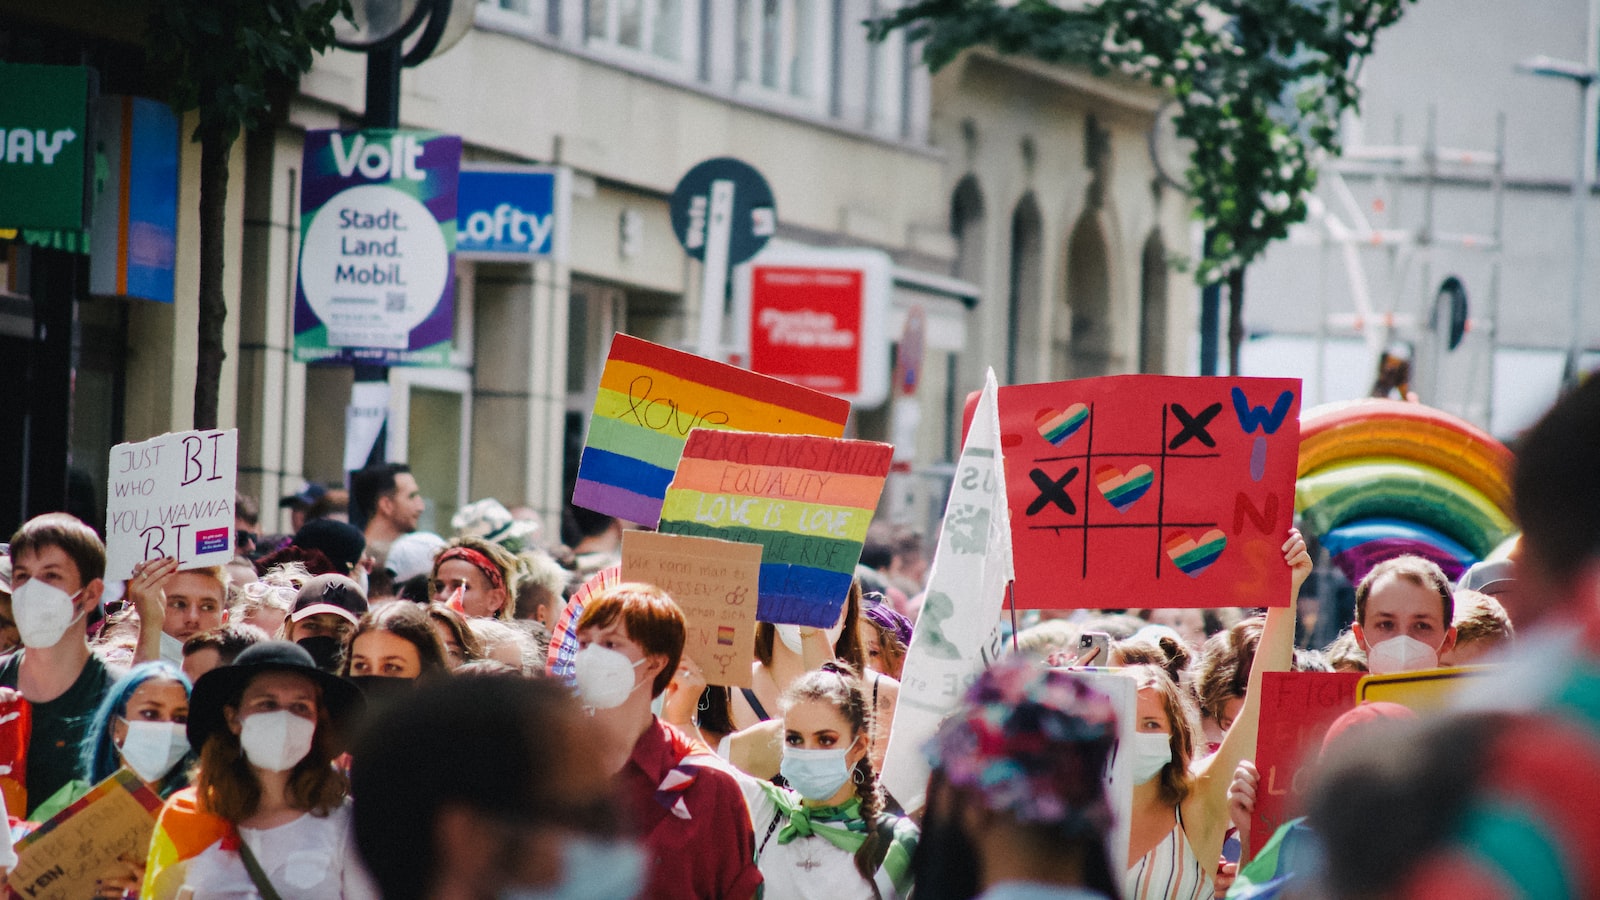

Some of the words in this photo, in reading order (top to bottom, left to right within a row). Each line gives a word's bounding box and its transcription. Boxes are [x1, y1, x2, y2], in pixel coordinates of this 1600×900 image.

[0, 128, 76, 164] AY
[330, 132, 426, 180] Volt
[339, 209, 407, 230] Stadt.
[341, 236, 403, 257] Land.
[335, 264, 406, 285] Mobil.
[618, 375, 729, 436] love
[120, 445, 166, 473] JUST
[181, 433, 224, 486] BI
[115, 479, 155, 497] WHO
[719, 465, 832, 500] EQUALITY
[113, 509, 149, 535] YOU
[159, 499, 230, 525] WANNA
[695, 493, 759, 526] LOVE
[763, 502, 785, 527] IS
[799, 505, 852, 537] LOVE
[139, 524, 190, 564] BI
[767, 535, 794, 561] WE
[800, 538, 845, 569] RISE
